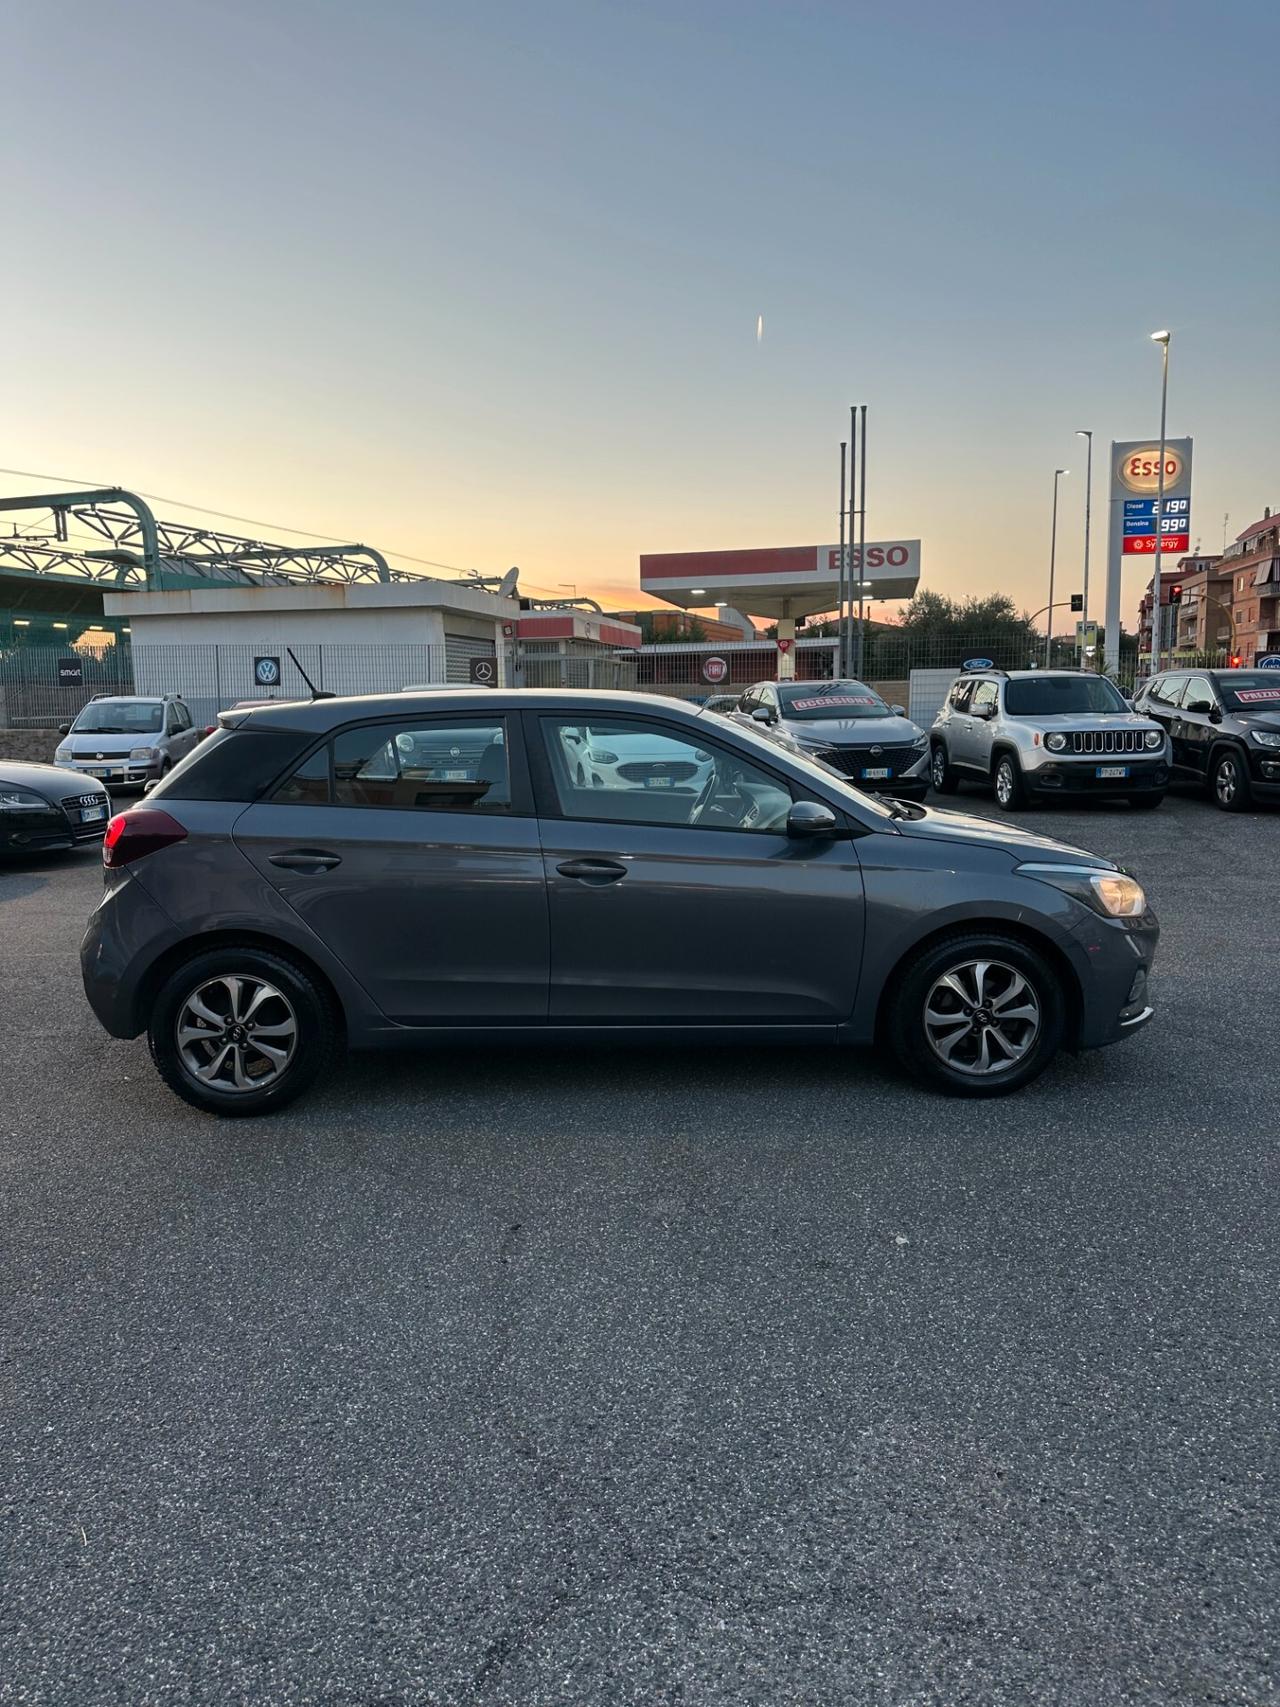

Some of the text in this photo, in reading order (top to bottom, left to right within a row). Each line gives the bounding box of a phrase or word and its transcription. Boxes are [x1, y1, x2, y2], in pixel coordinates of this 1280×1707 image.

[1130, 457, 1177, 477] Esso
[1126, 501, 1144, 509] Diesel
[1145, 539, 1179, 550] Syergy
[828, 545, 909, 570] ESSO
